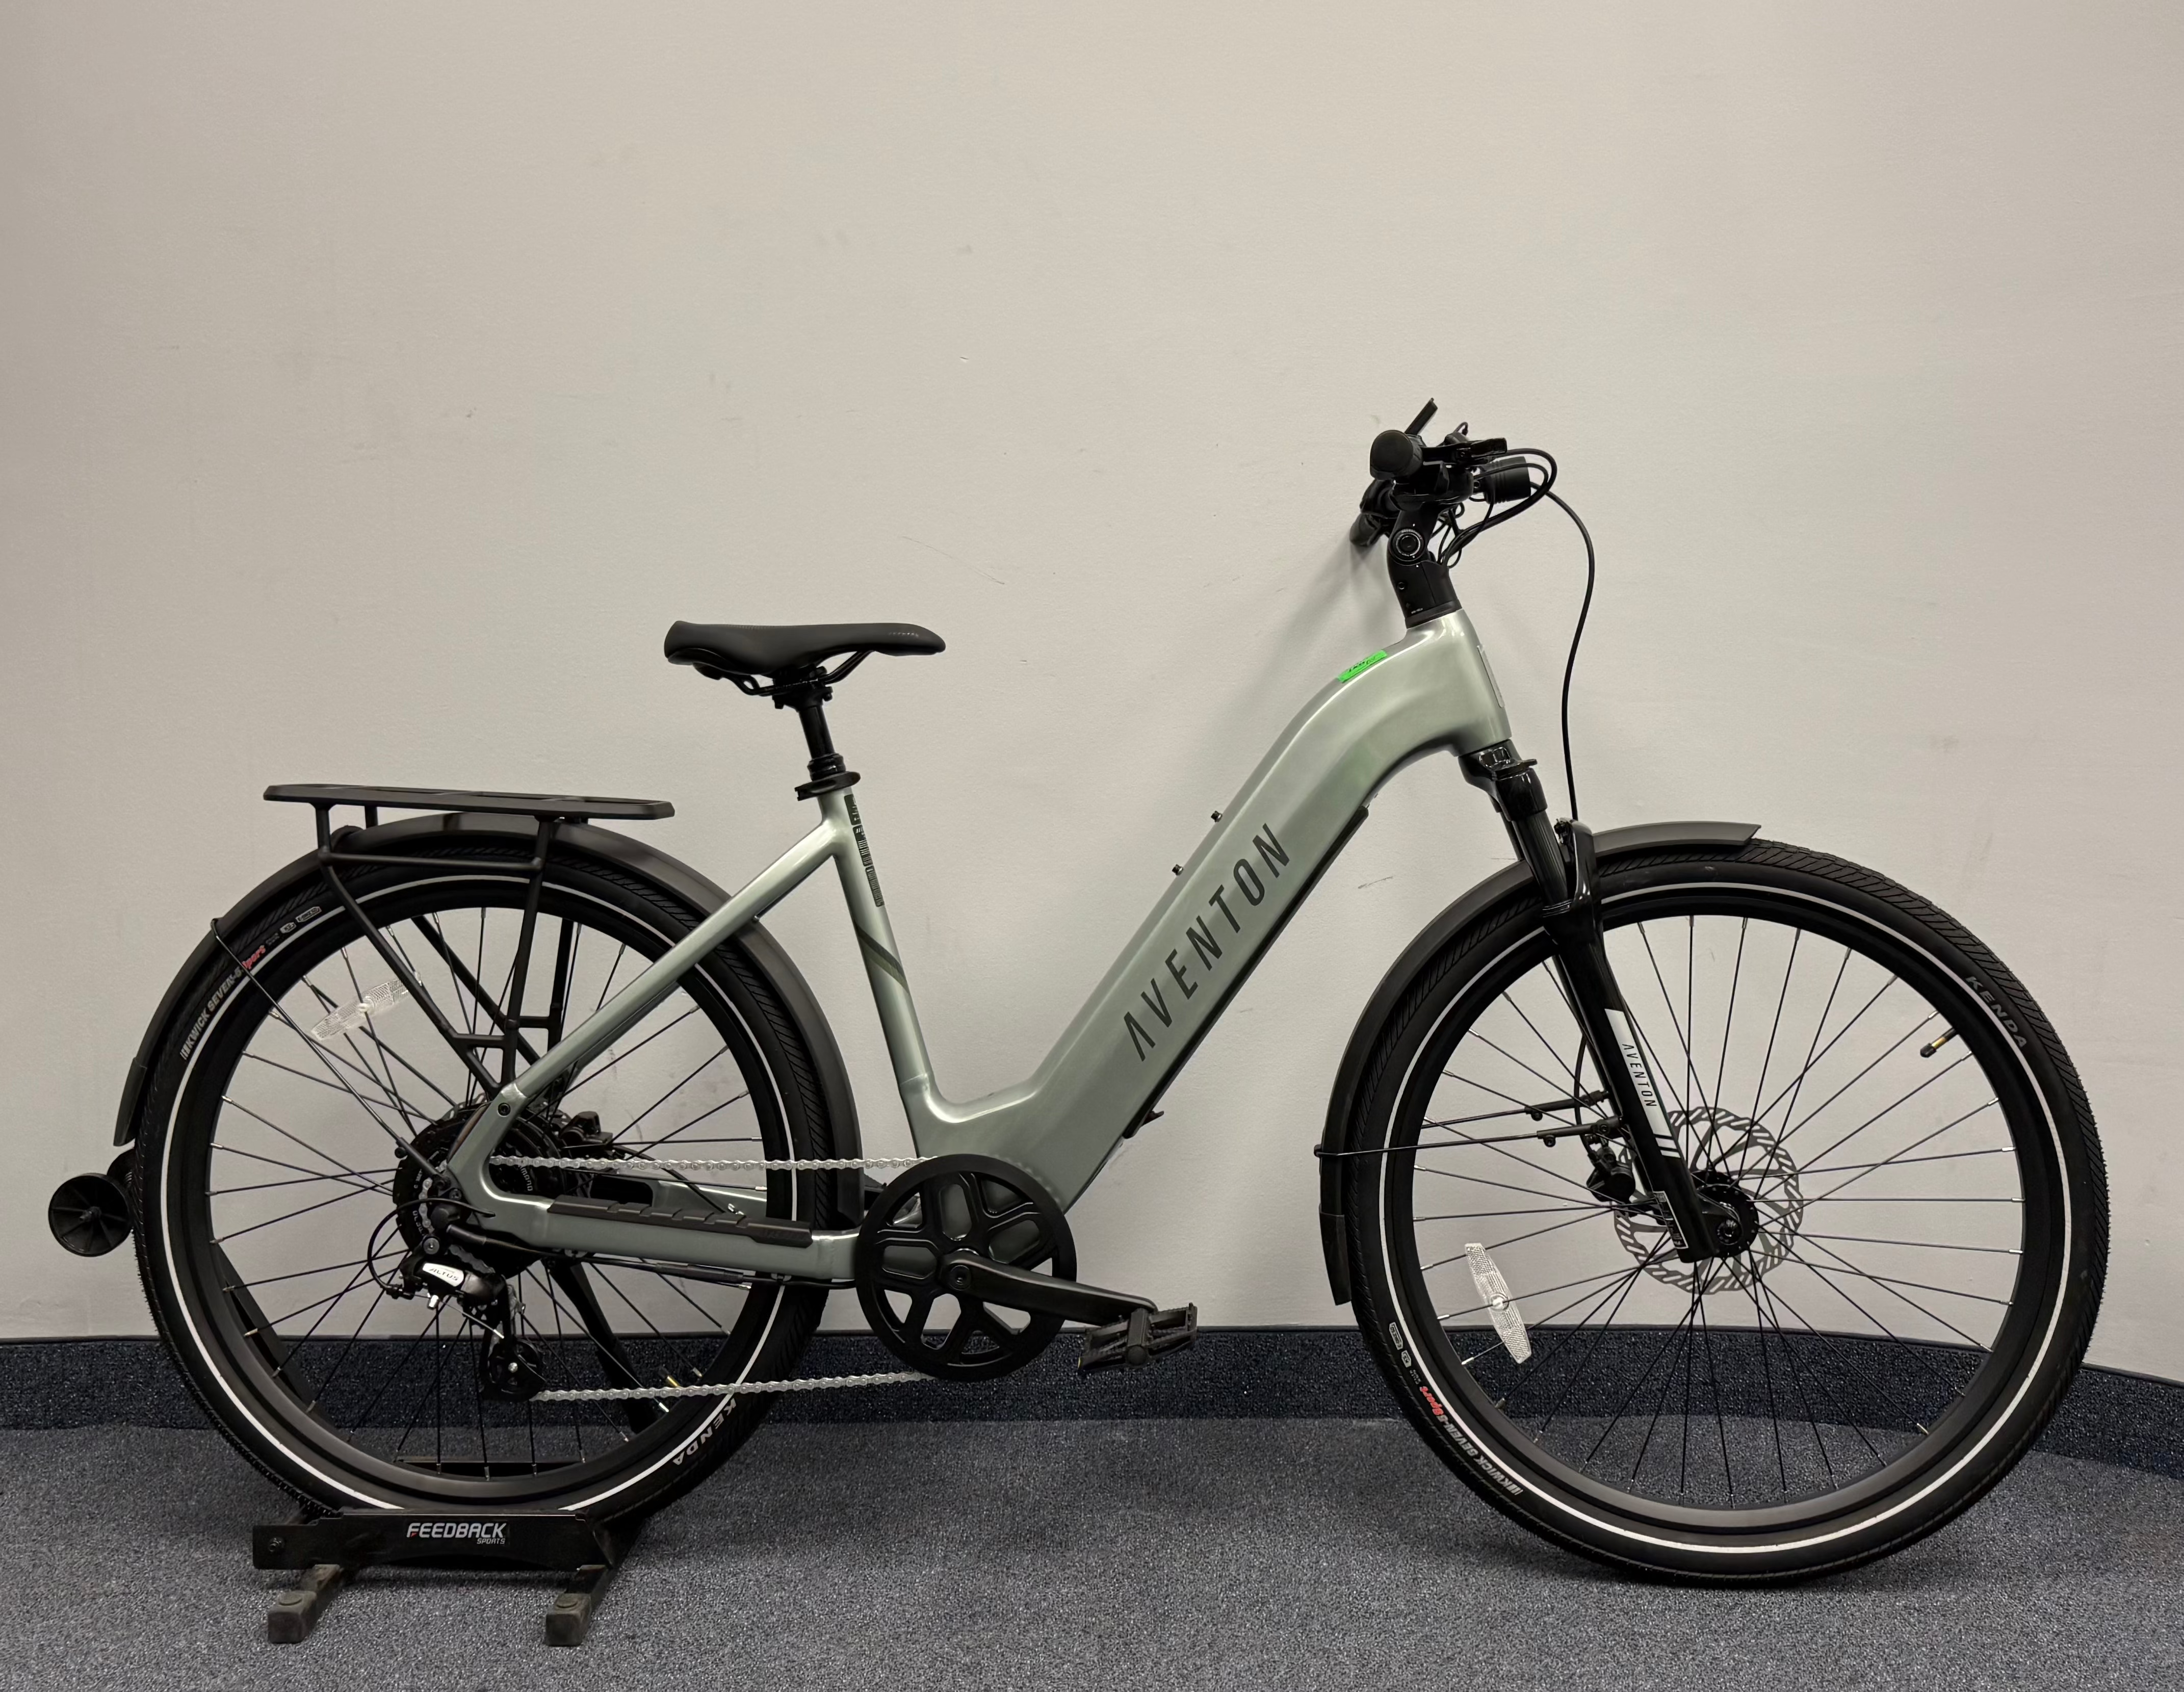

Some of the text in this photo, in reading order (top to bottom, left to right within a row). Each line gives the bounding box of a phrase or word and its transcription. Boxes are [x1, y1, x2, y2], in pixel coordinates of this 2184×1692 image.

[1124, 823, 1290, 1062] AVENTON
[185, 1007, 210, 1049] KWICK
[1965, 976, 2027, 1048] KENDA
[1622, 1044, 1657, 1106] AVENTON
[429, 1268, 459, 1281] ALTUS
[672, 1398, 737, 1465] KENDA
[1473, 1455, 1513, 1489] KWICK
[406, 1522, 507, 1538] FEEDBACK
